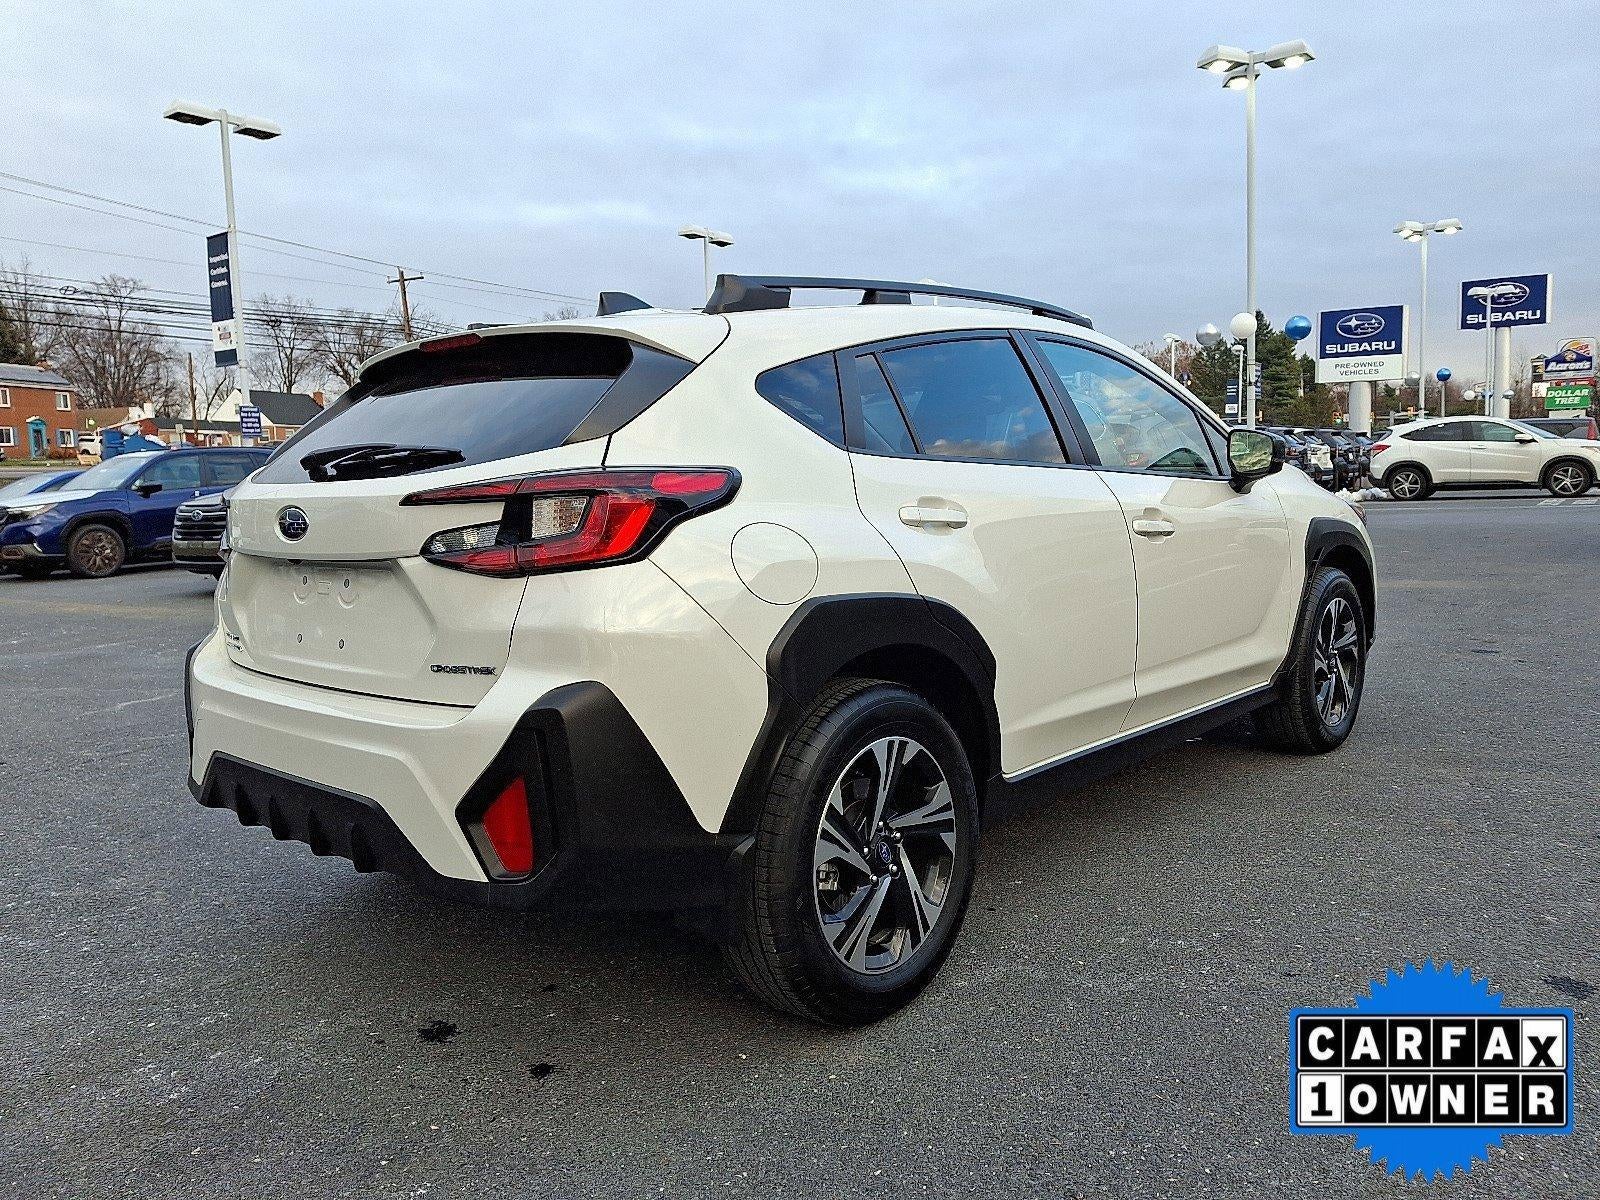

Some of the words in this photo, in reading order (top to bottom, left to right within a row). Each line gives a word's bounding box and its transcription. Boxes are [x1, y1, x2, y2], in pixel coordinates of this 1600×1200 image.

[1325, 341, 1395, 354] SUBARU
[1335, 361, 1384, 369] PRE-OWNED
[1547, 389, 1589, 397] DOLLAR
[430, 665, 497, 676] CROSSTREK
